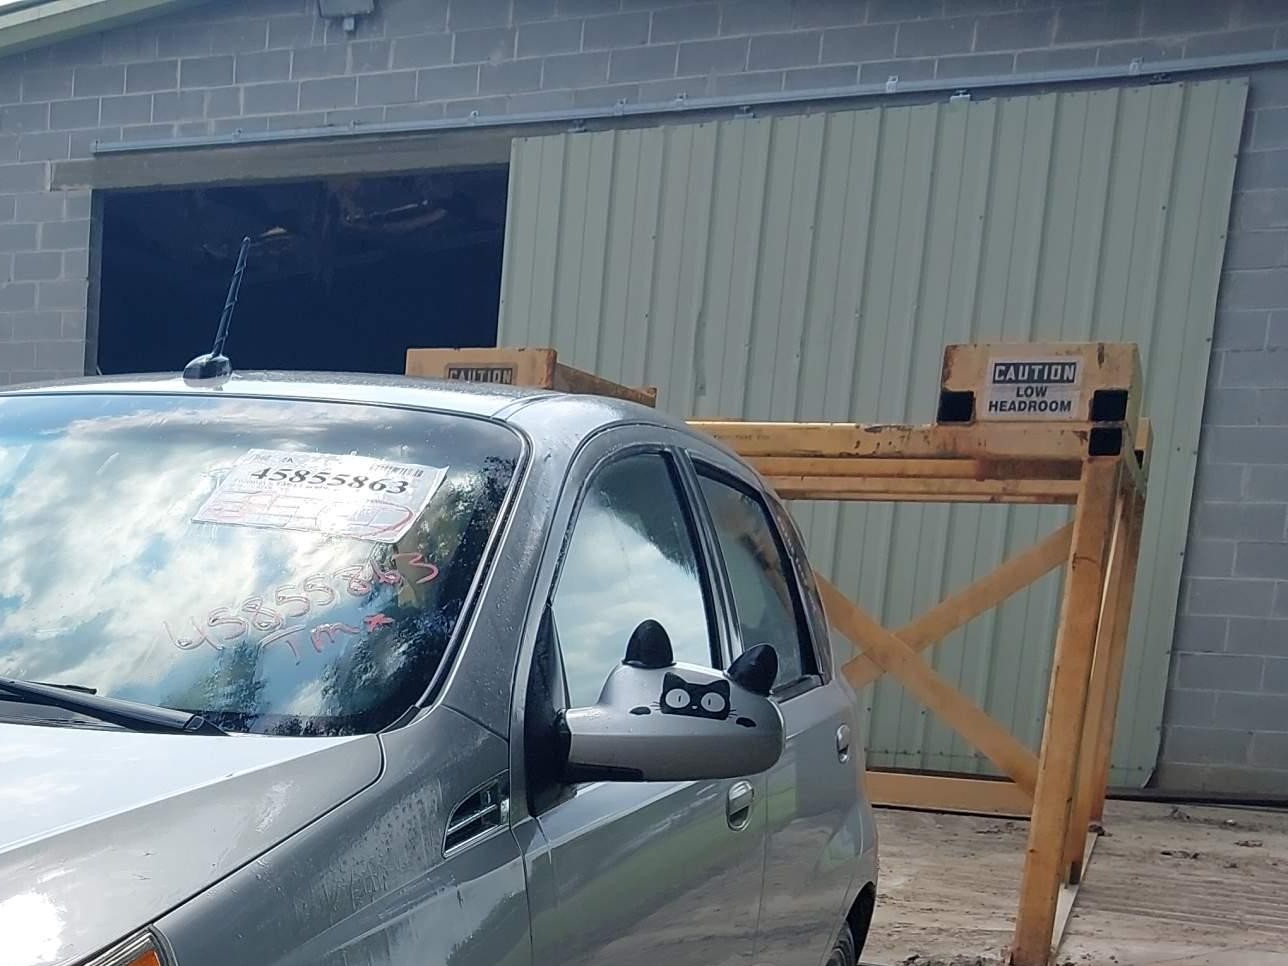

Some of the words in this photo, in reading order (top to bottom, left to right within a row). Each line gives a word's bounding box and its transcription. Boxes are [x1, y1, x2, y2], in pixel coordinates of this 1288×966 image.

[449, 368, 513, 384] CAUTION
[993, 363, 1077, 382] CAUTION
[1015, 385, 1048, 398] LOW
[988, 400, 1072, 413] HEADROOM
[250, 466, 410, 494] 45855863
